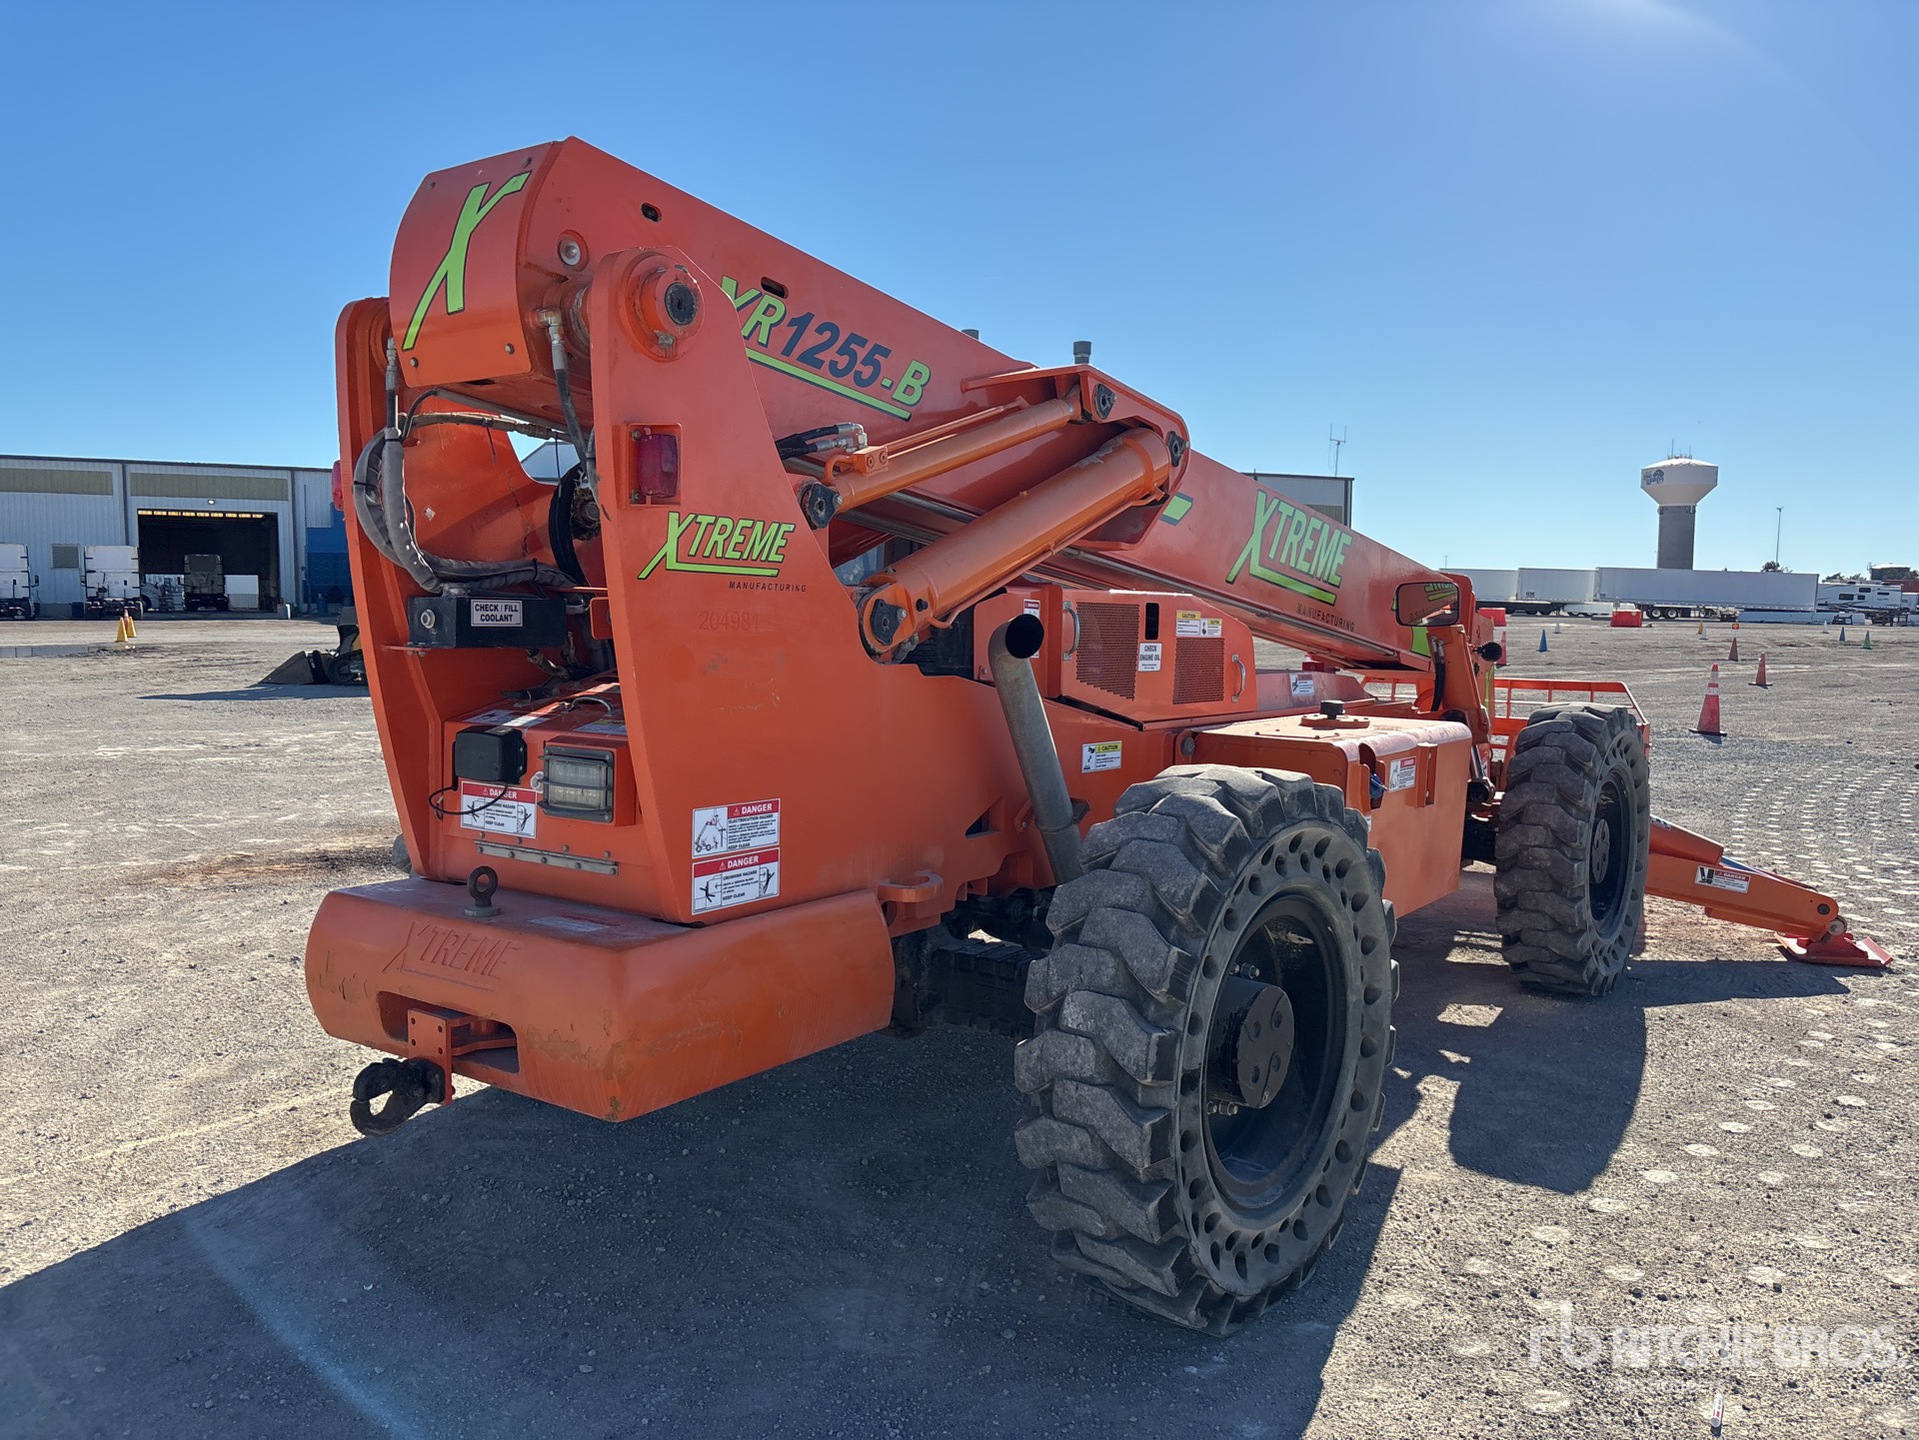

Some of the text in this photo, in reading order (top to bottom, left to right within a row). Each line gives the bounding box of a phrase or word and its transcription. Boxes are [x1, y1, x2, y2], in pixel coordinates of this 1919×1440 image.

[1225, 489, 1353, 588] XTREME
[637, 511, 796, 580] XTREME
[728, 580, 808, 593] MANUFACTURING
[474, 603, 499, 612] CHECK
[504, 604, 519, 612] FILL
[480, 613, 513, 622] COOLANT
[1296, 602, 1355, 632] MANUFACTURING
[741, 803, 773, 815] DANGER
[727, 855, 759, 869] DANGER
